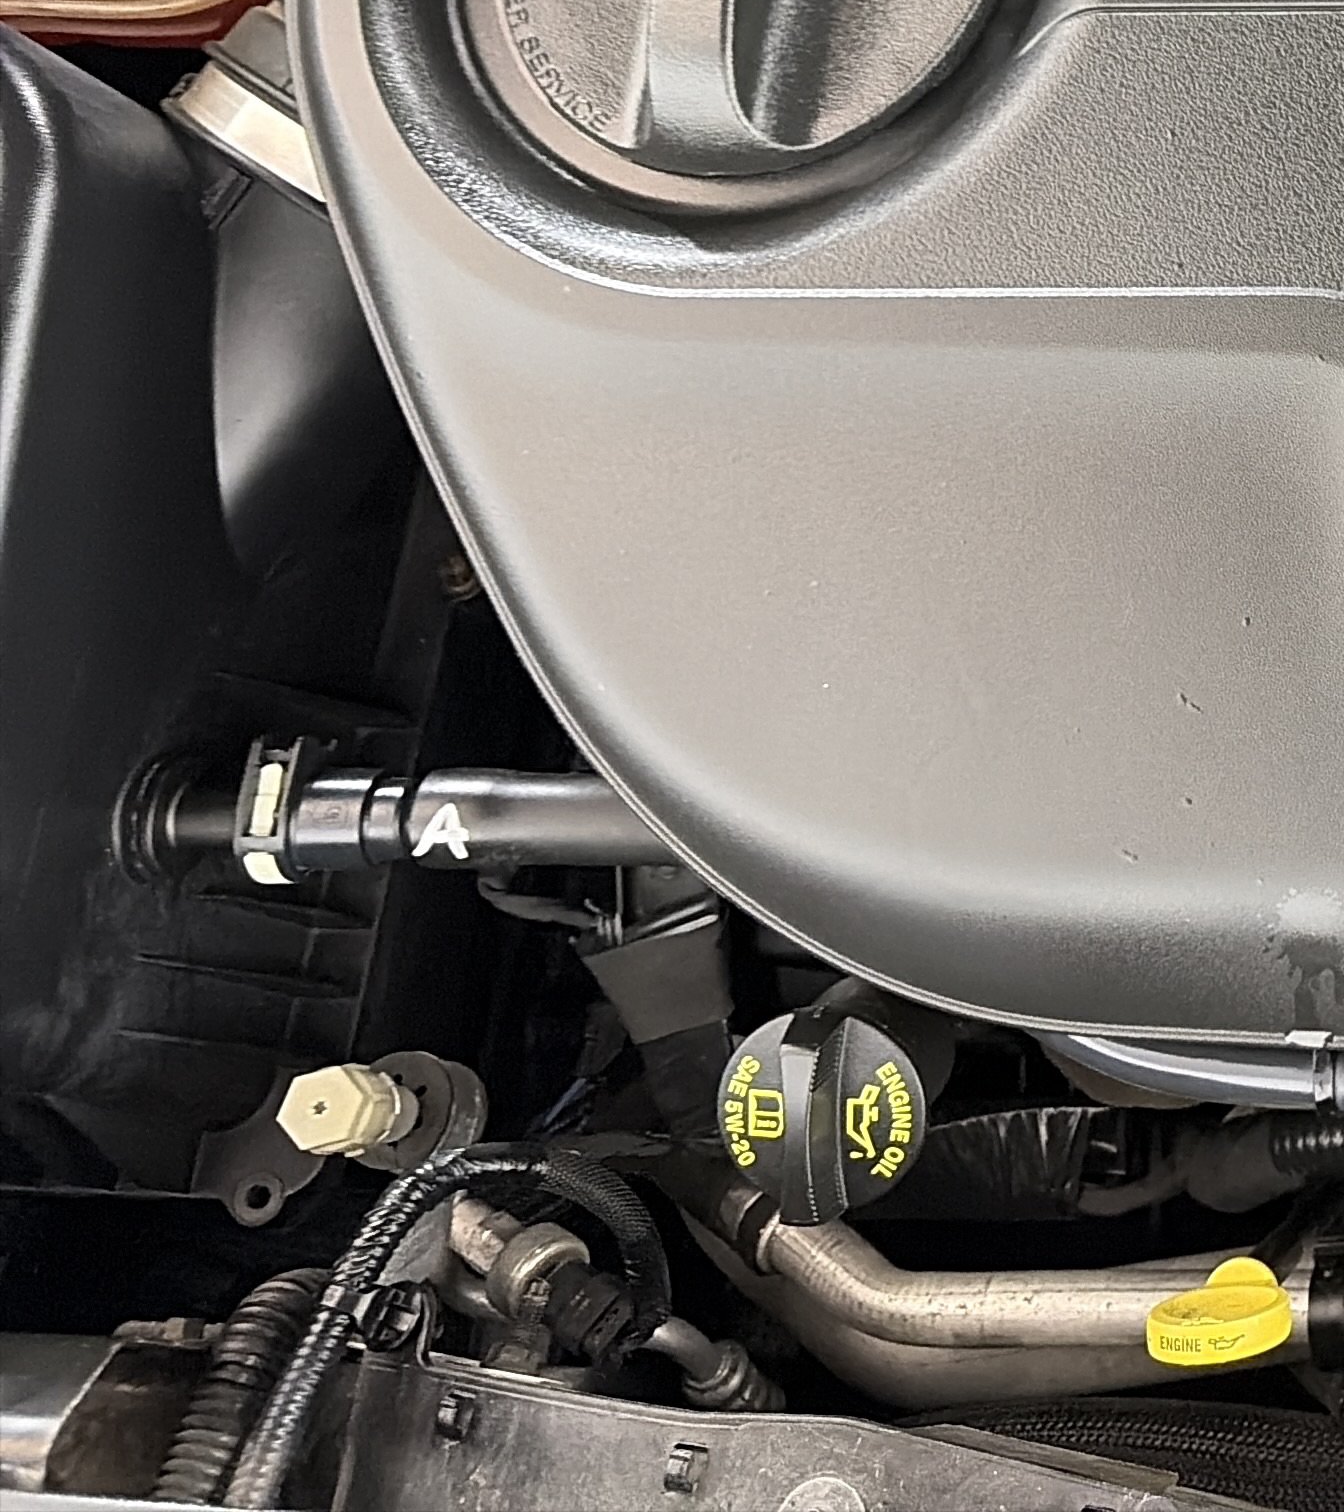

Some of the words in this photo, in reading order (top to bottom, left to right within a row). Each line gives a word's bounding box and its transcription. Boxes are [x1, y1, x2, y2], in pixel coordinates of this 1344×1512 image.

[519, 35, 614, 134] SERVICE
[411, 802, 471, 860] A
[727, 1054, 762, 1098] SAE
[875, 1061, 913, 1144] ENGINE
[723, 1099, 757, 1168] 5W-20
[870, 1142, 906, 1179] OIL
[1159, 1335, 1202, 1353] ENGINE
